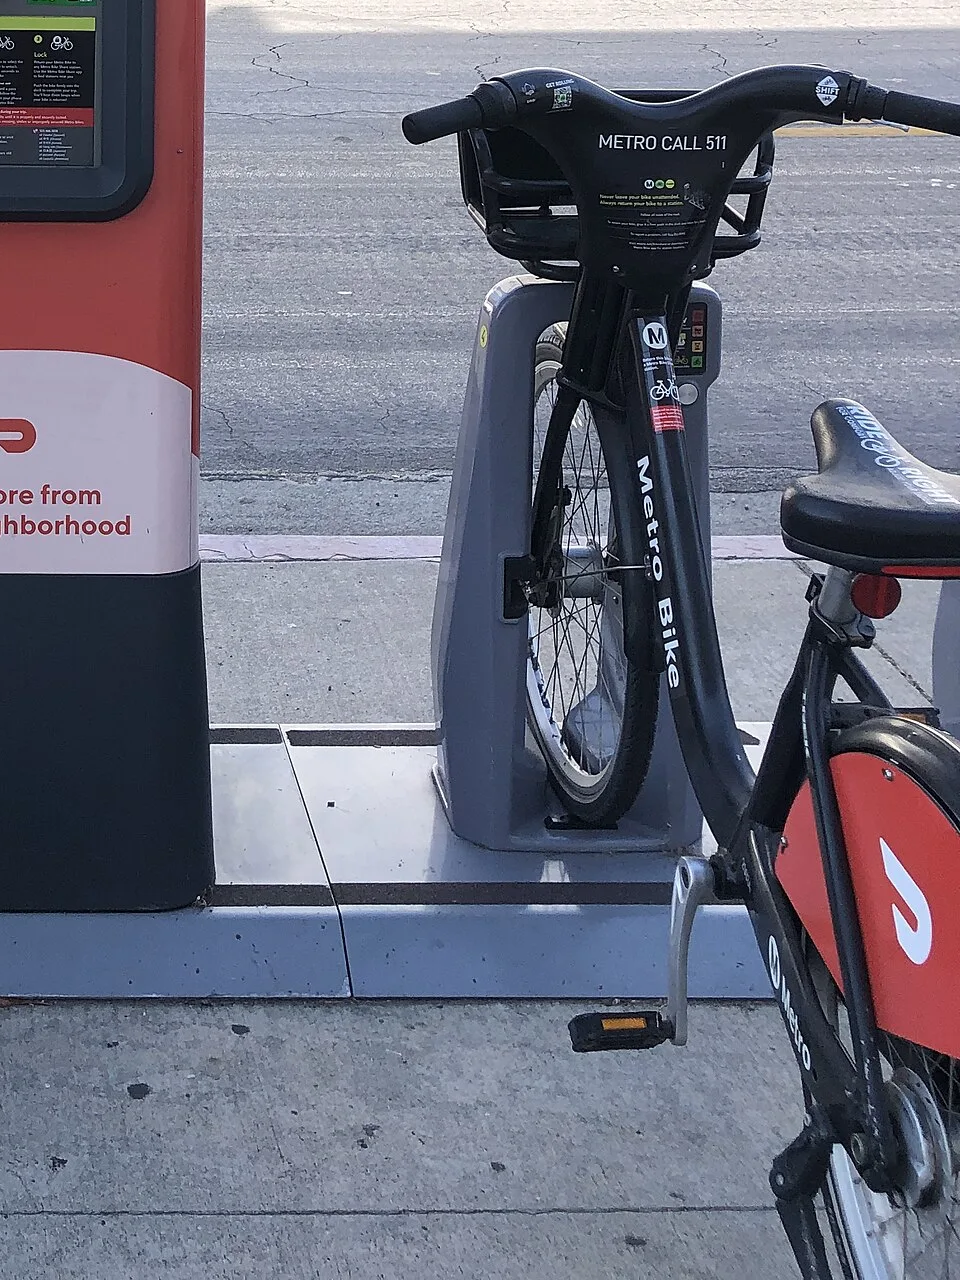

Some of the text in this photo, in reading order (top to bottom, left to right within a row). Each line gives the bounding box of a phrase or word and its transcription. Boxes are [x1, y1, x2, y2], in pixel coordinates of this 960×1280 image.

[815, 86, 840, 95] SHIFT
[598, 134, 726, 151] METRO CALL 511
[846, 405, 888, 440] RIDE
[40, 484, 101, 505] from
[636, 455, 681, 689] Metro Bike
[781, 974, 811, 1071] Metro
